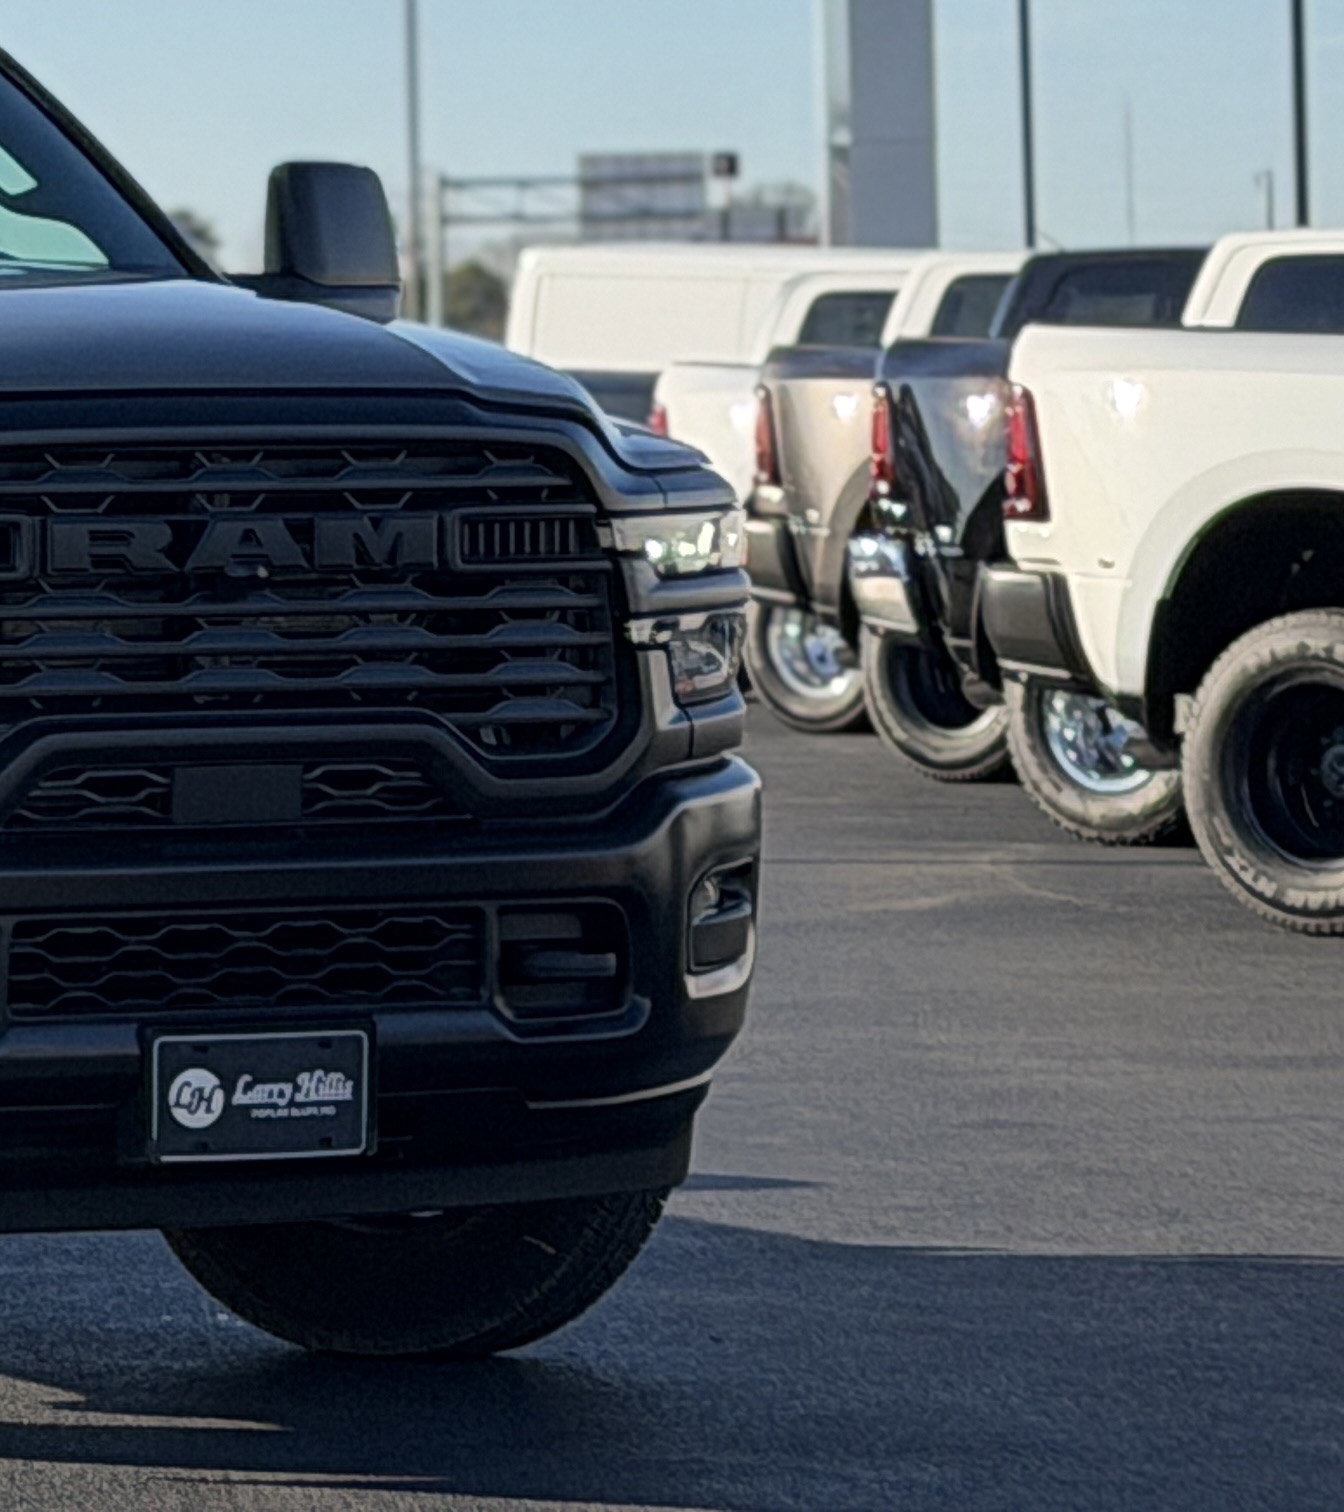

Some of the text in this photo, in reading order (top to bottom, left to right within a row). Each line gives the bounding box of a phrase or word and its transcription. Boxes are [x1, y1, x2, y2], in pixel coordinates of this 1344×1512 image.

[46, 509, 439, 577] RAM
[231, 1068, 354, 1106] Larry Hillis
